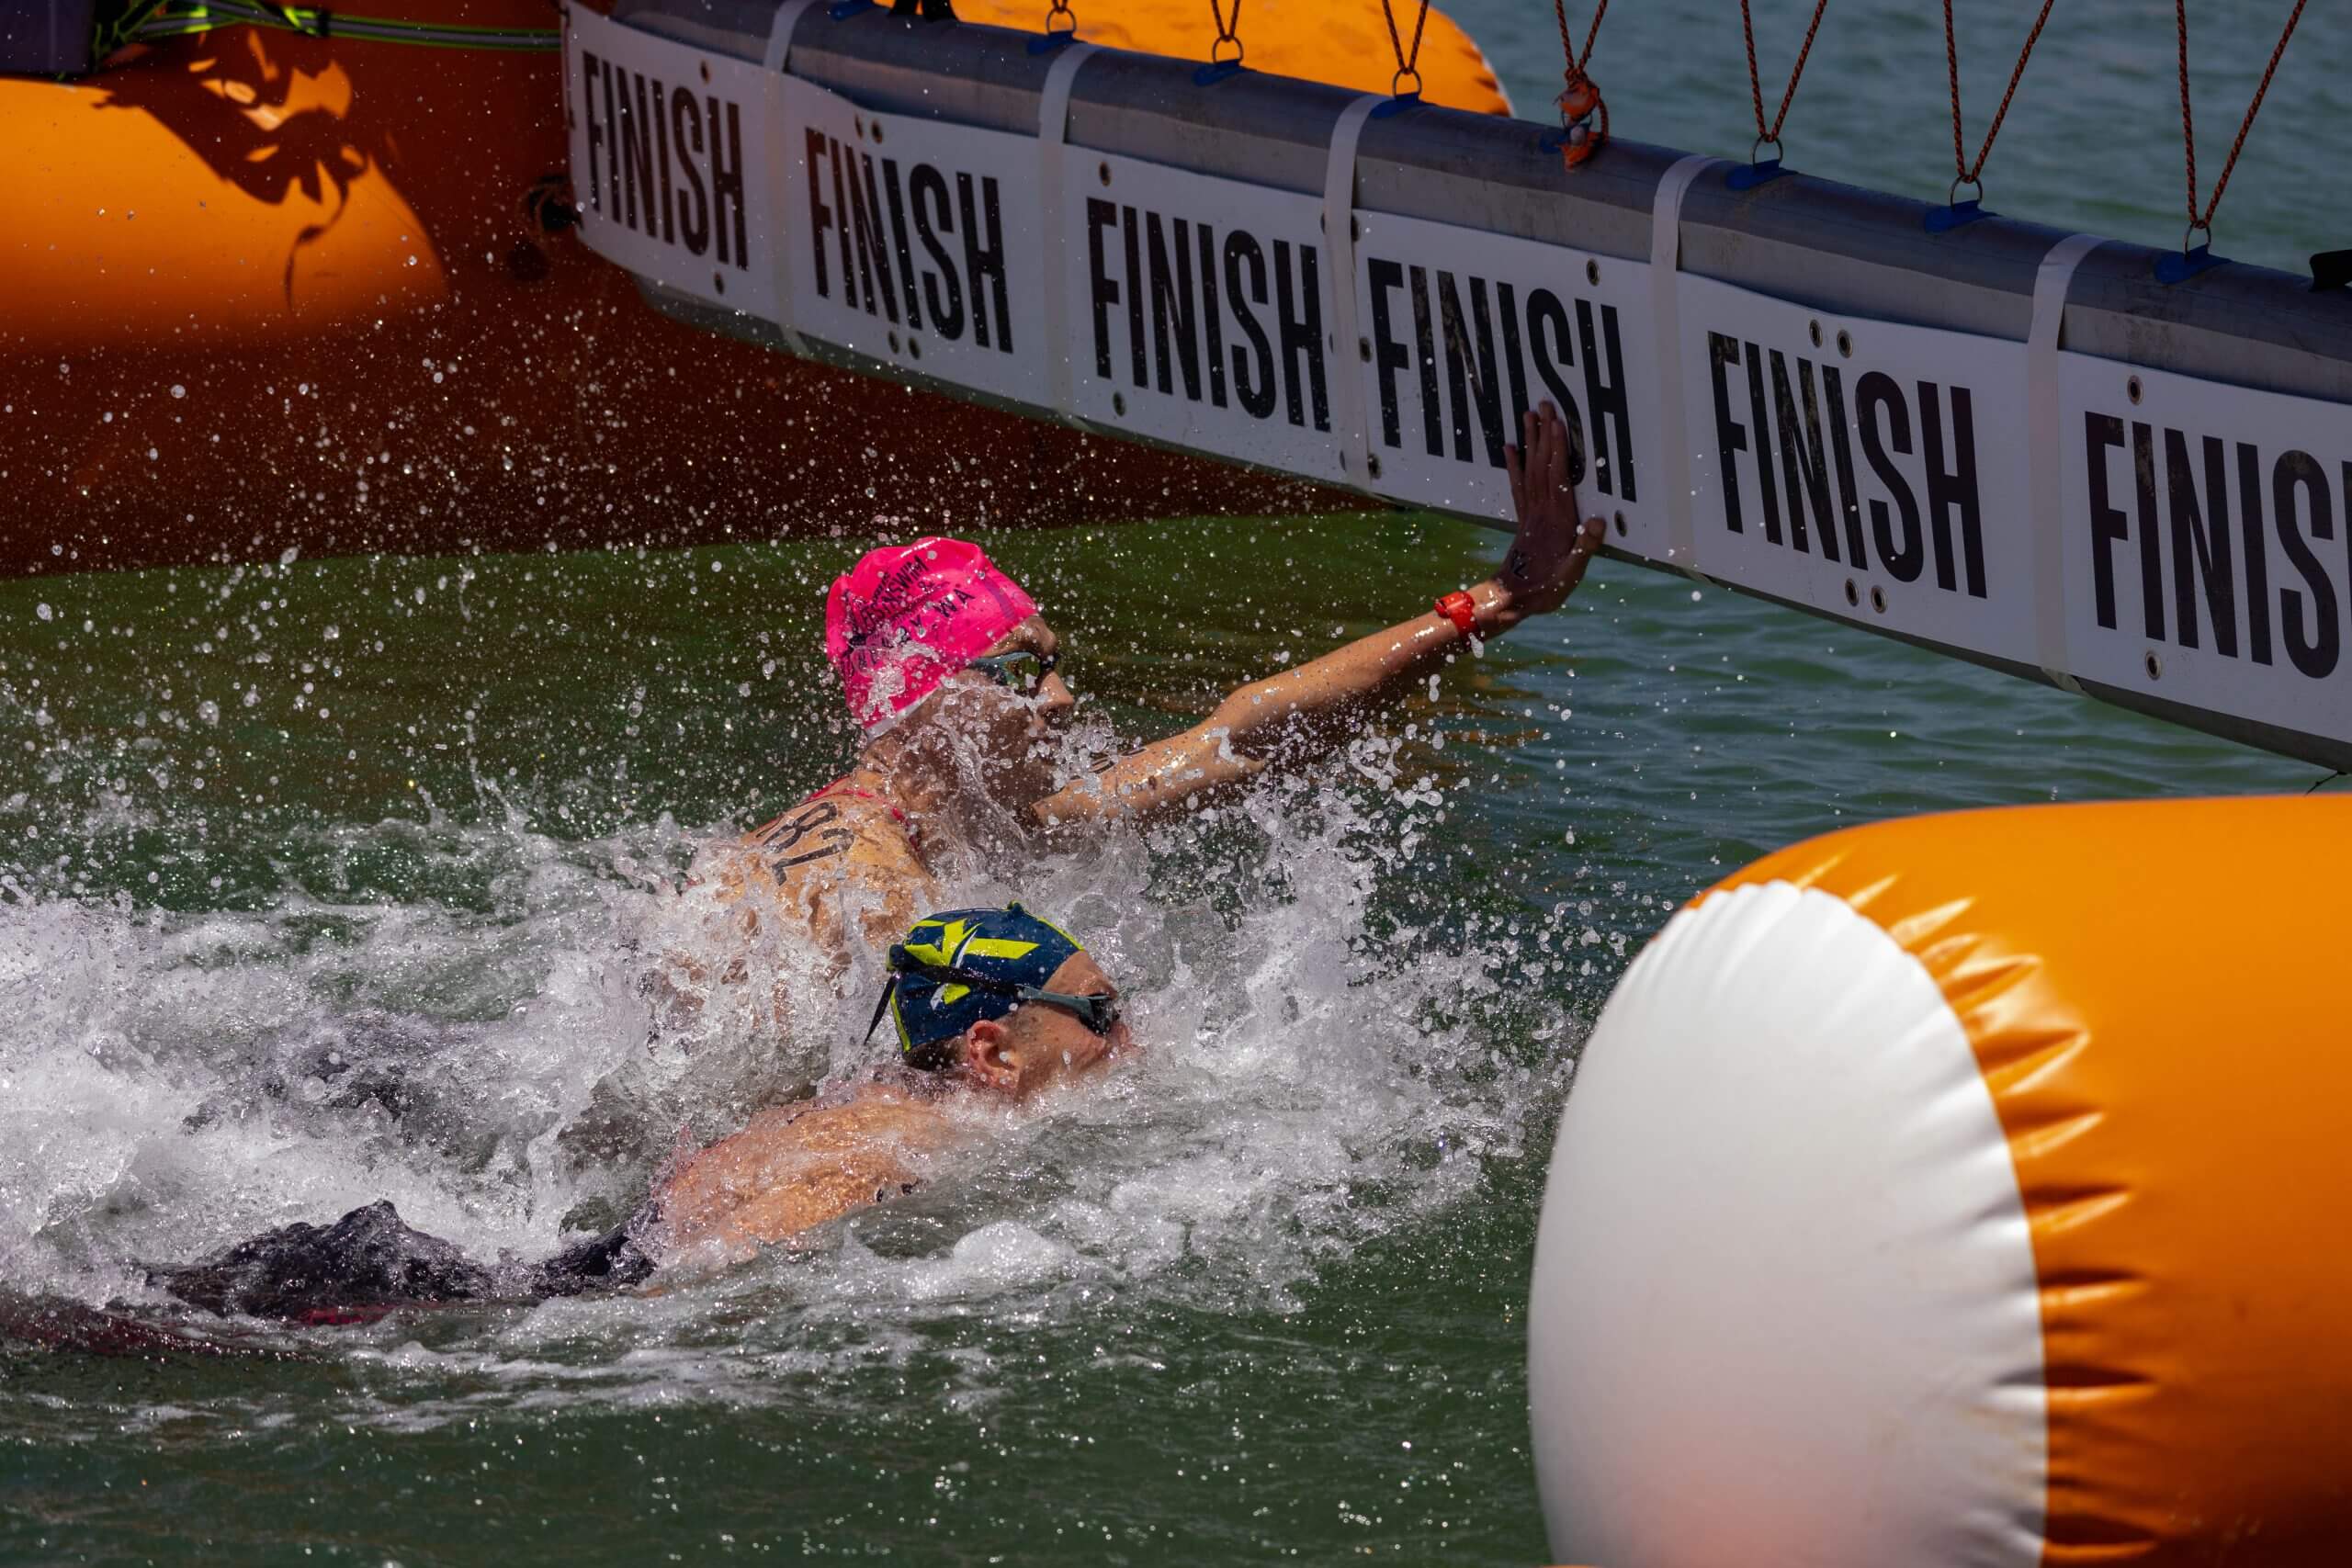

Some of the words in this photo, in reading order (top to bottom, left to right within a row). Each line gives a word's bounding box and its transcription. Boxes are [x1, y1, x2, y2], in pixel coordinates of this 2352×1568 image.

[582, 51, 749, 272] FINISH
[805, 128, 1014, 354] FINISH
[1086, 197, 1331, 433] FINISH
[1367, 257, 1636, 502] FINISH
[1708, 331, 1988, 599] FINISH
[2086, 411, 2352, 679] FINIS
